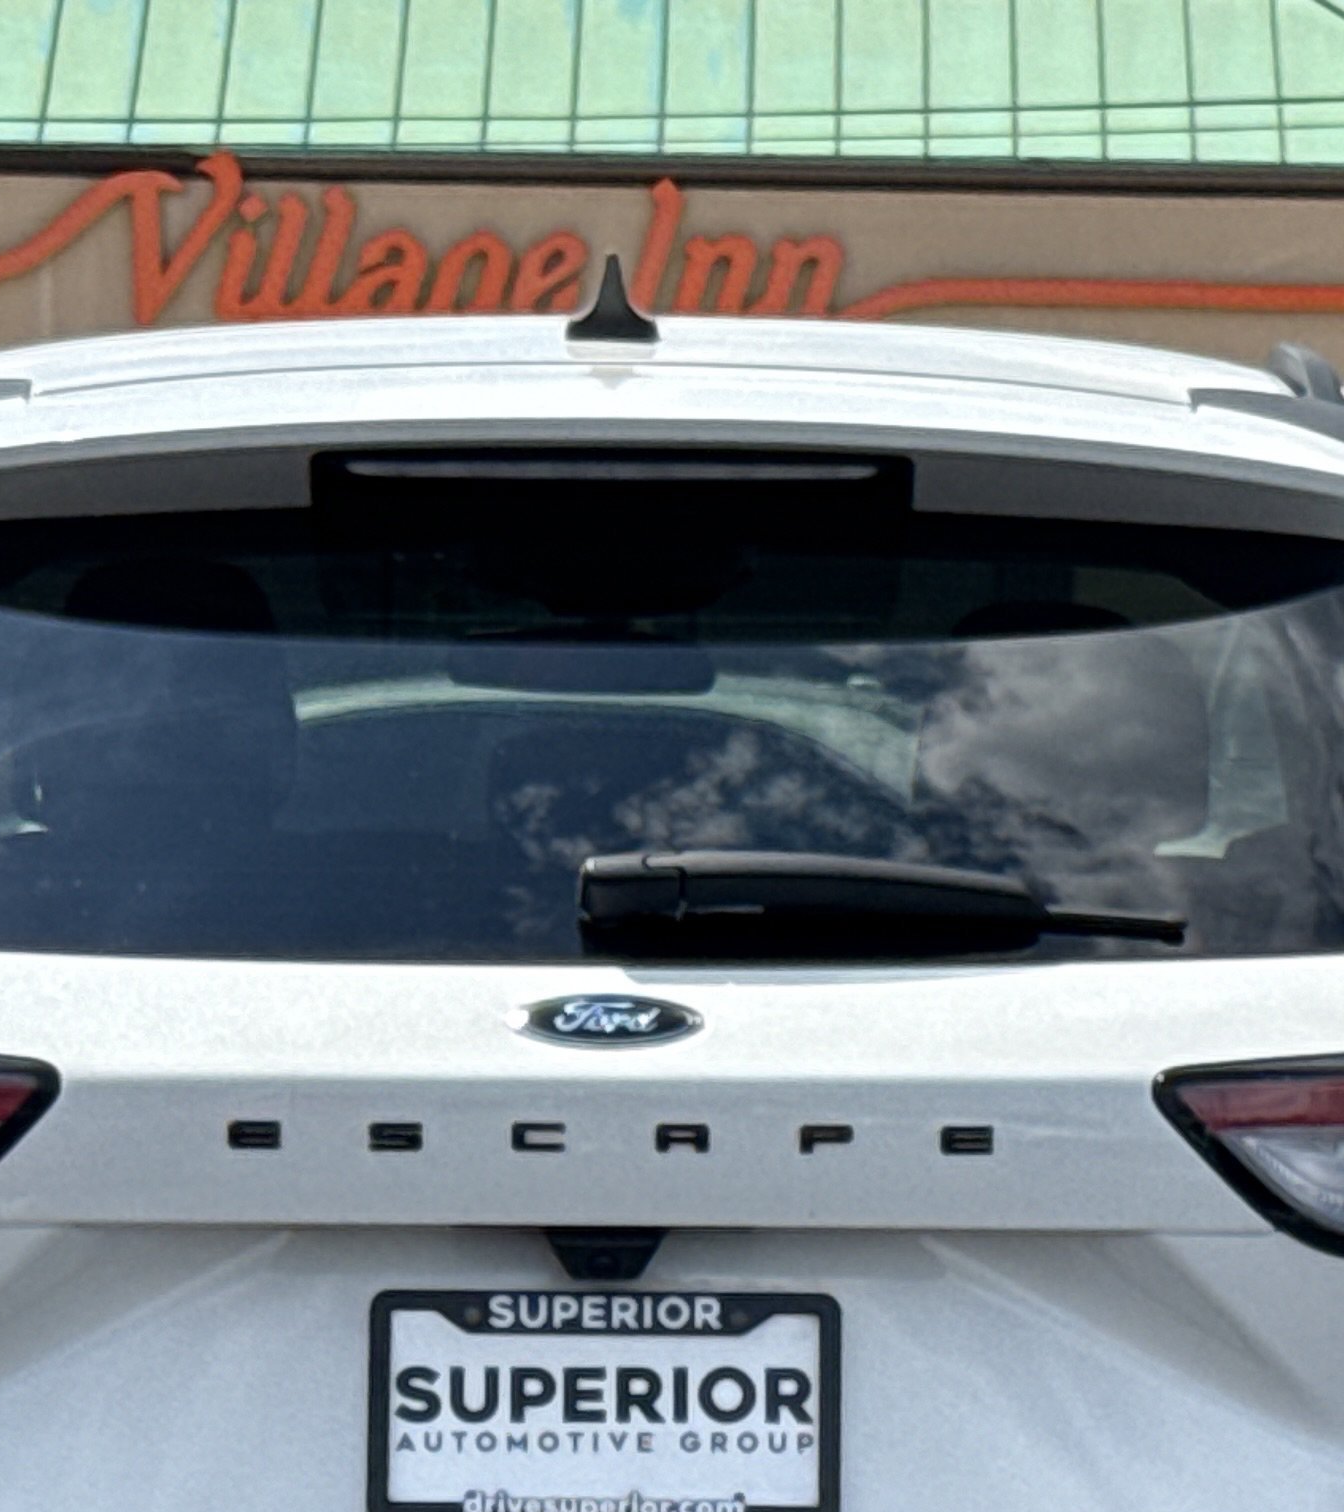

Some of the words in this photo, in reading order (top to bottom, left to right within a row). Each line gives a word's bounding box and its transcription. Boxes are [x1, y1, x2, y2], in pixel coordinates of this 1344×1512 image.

[628, 179, 844, 316] Inn
[554, 999, 661, 1033] Ford
[227, 1119, 995, 1155] ESCAPE
[487, 1295, 723, 1331] SUPERIOR
[394, 1365, 813, 1425] SUPERIOR
[395, 1430, 655, 1454] AUTOMOTIVE
[679, 1430, 815, 1455] GROUP
